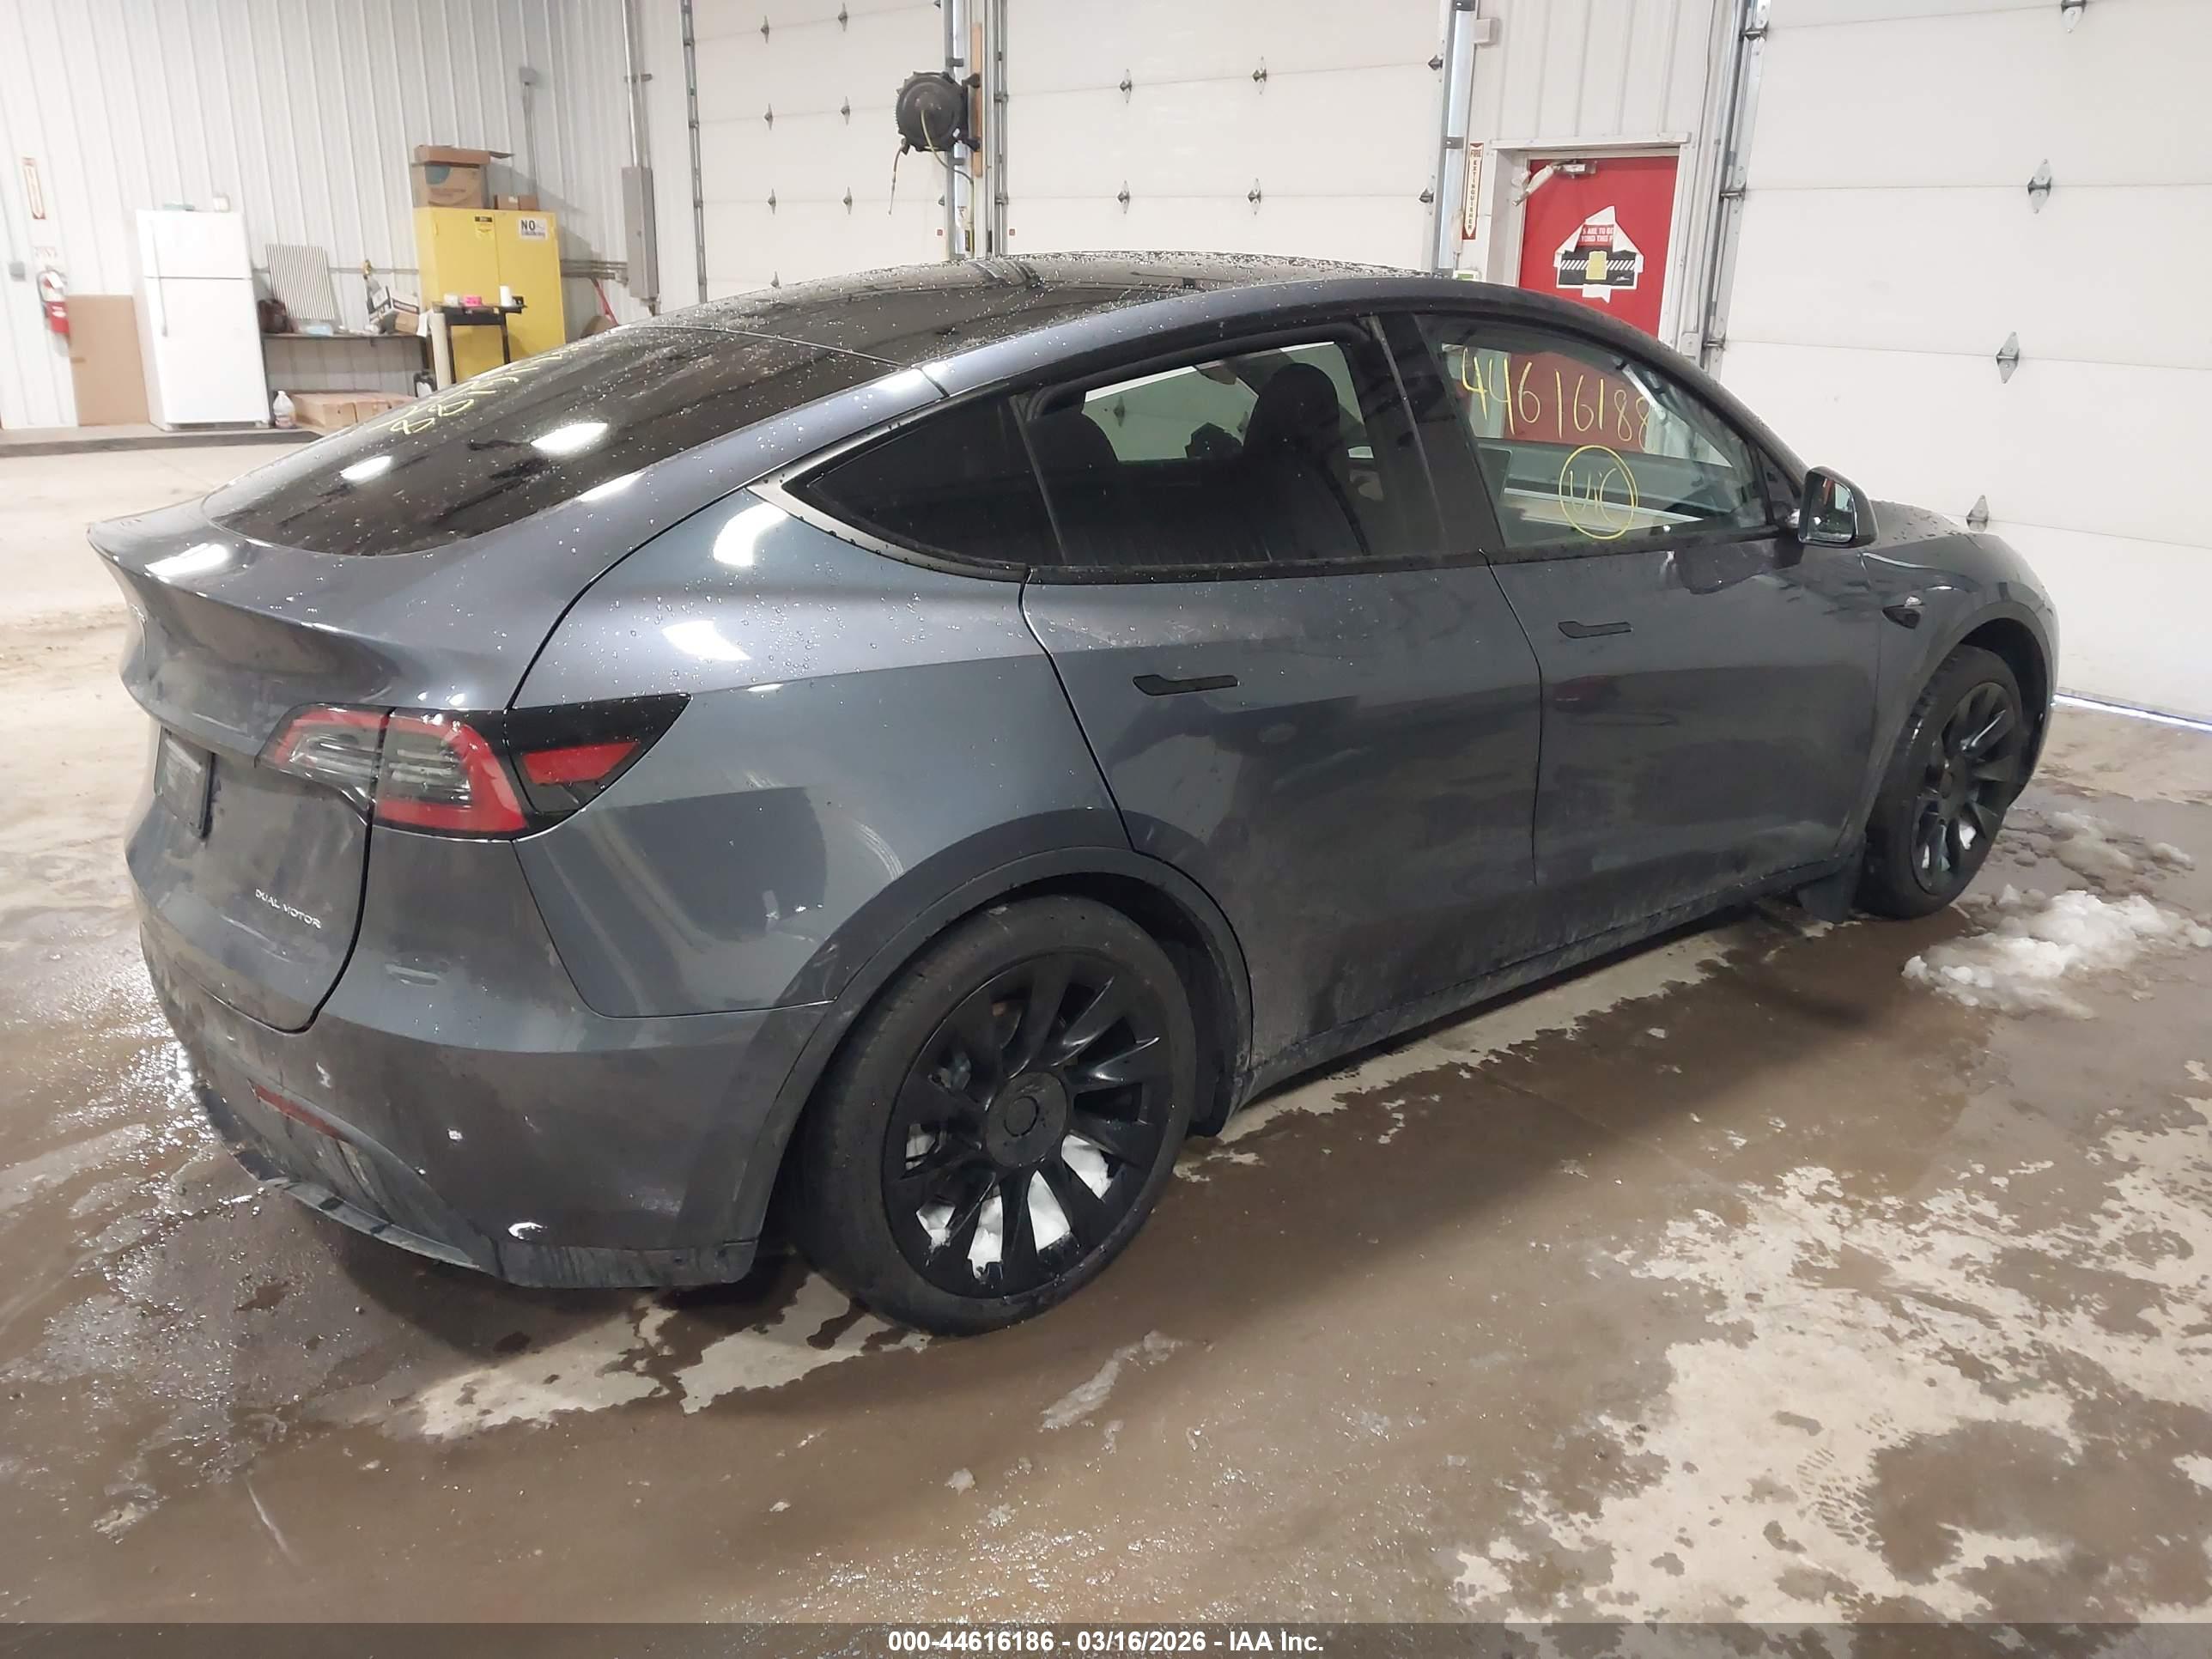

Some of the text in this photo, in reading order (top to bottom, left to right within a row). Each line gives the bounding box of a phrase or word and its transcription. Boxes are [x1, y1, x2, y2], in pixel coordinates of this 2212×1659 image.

[520, 219, 536, 231] NO
[256, 889, 322, 928] DUAL MOTOR
